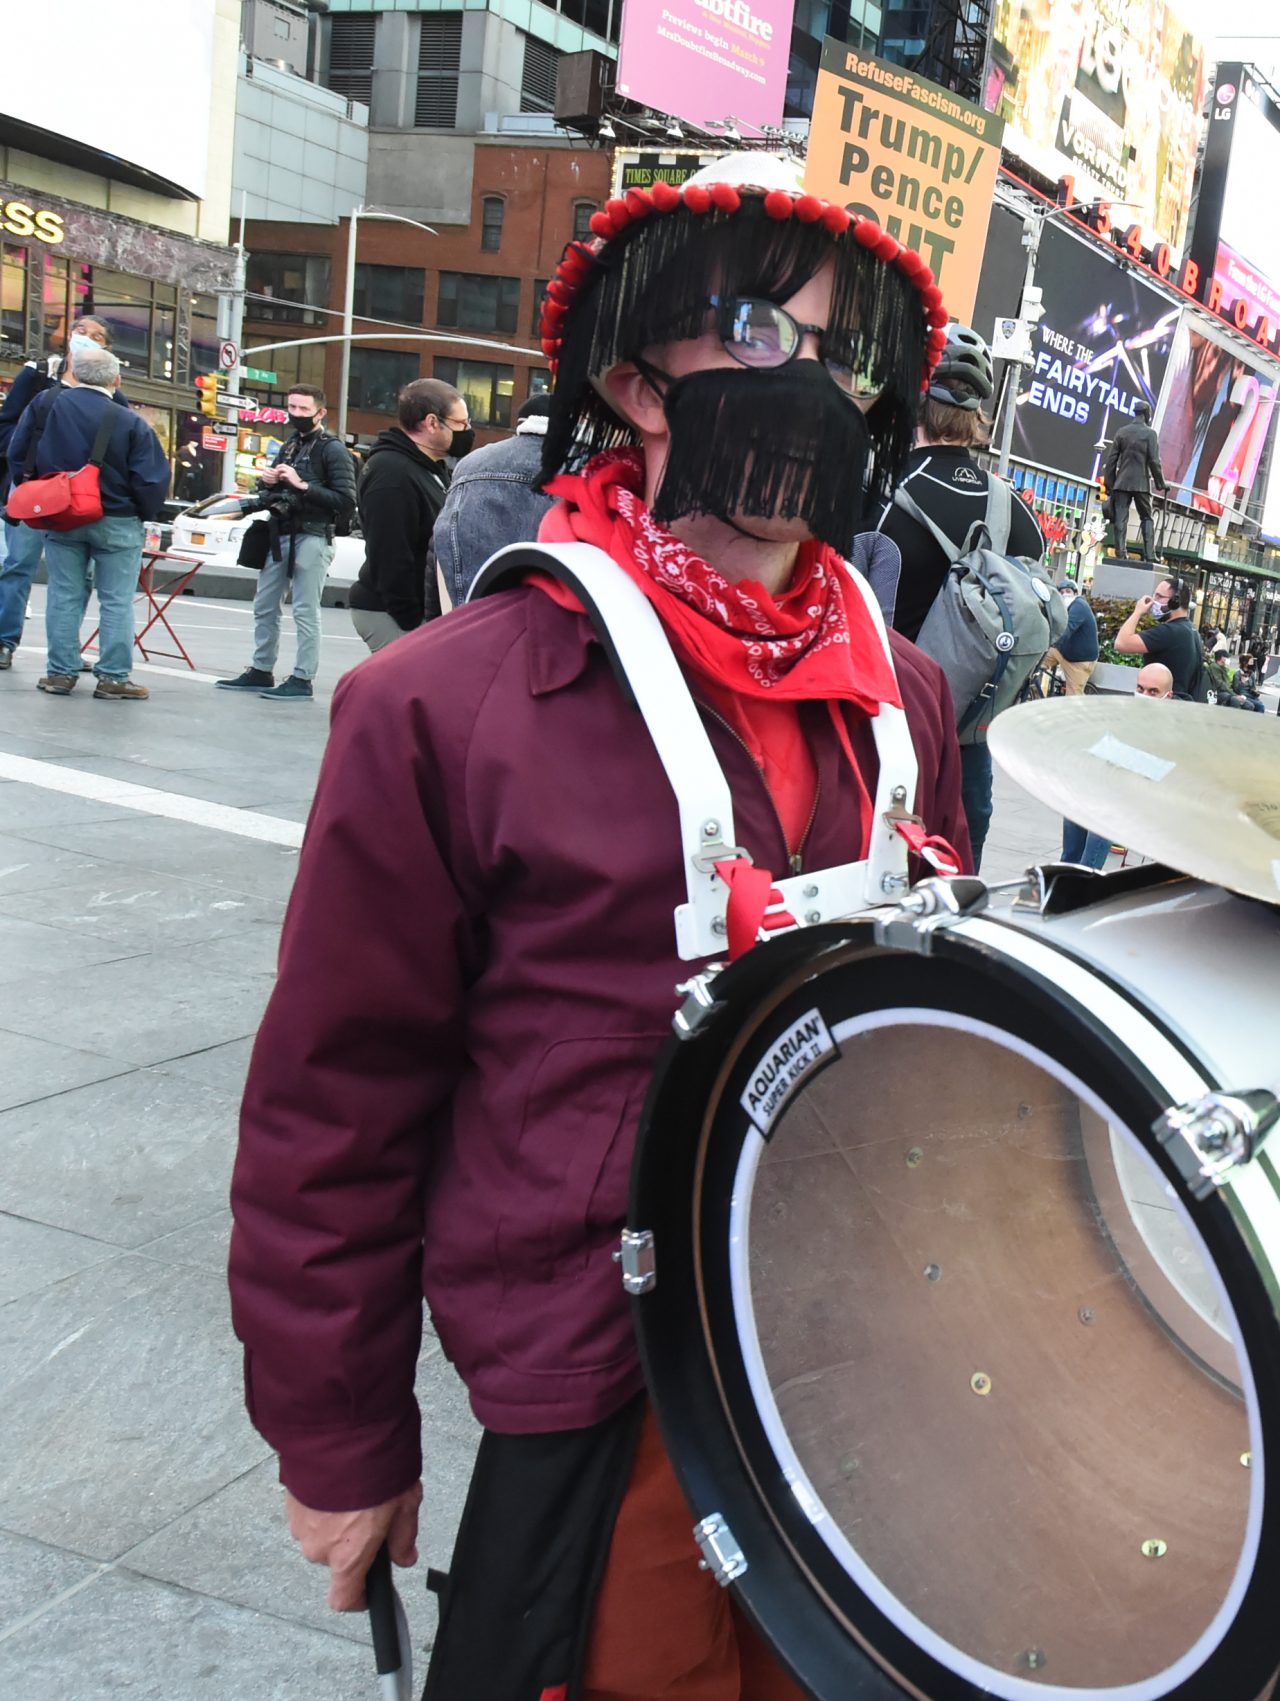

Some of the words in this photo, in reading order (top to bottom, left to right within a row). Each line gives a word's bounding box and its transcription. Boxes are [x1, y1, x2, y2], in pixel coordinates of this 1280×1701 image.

[661, 10, 703, 36] Previews
[704, 29, 729, 50] begin
[845, 52, 986, 136] RefuseFascism.org
[1214, 107, 1232, 121] LG
[838, 86, 985, 185] Trump/
[625, 168, 651, 184] TIMES
[653, 168, 687, 185] SQUARE
[839, 142, 965, 229] Pence
[1041, 325, 1075, 356] WHERE
[1075, 343, 1094, 365] THE
[1028, 381, 1090, 424] ENDS
[1034, 351, 1145, 418] FAIRYTALE
[747, 1021, 820, 1112] AQUARIAN
[762, 1078, 790, 1117] SUPER
[787, 1052, 812, 1081] KICK
